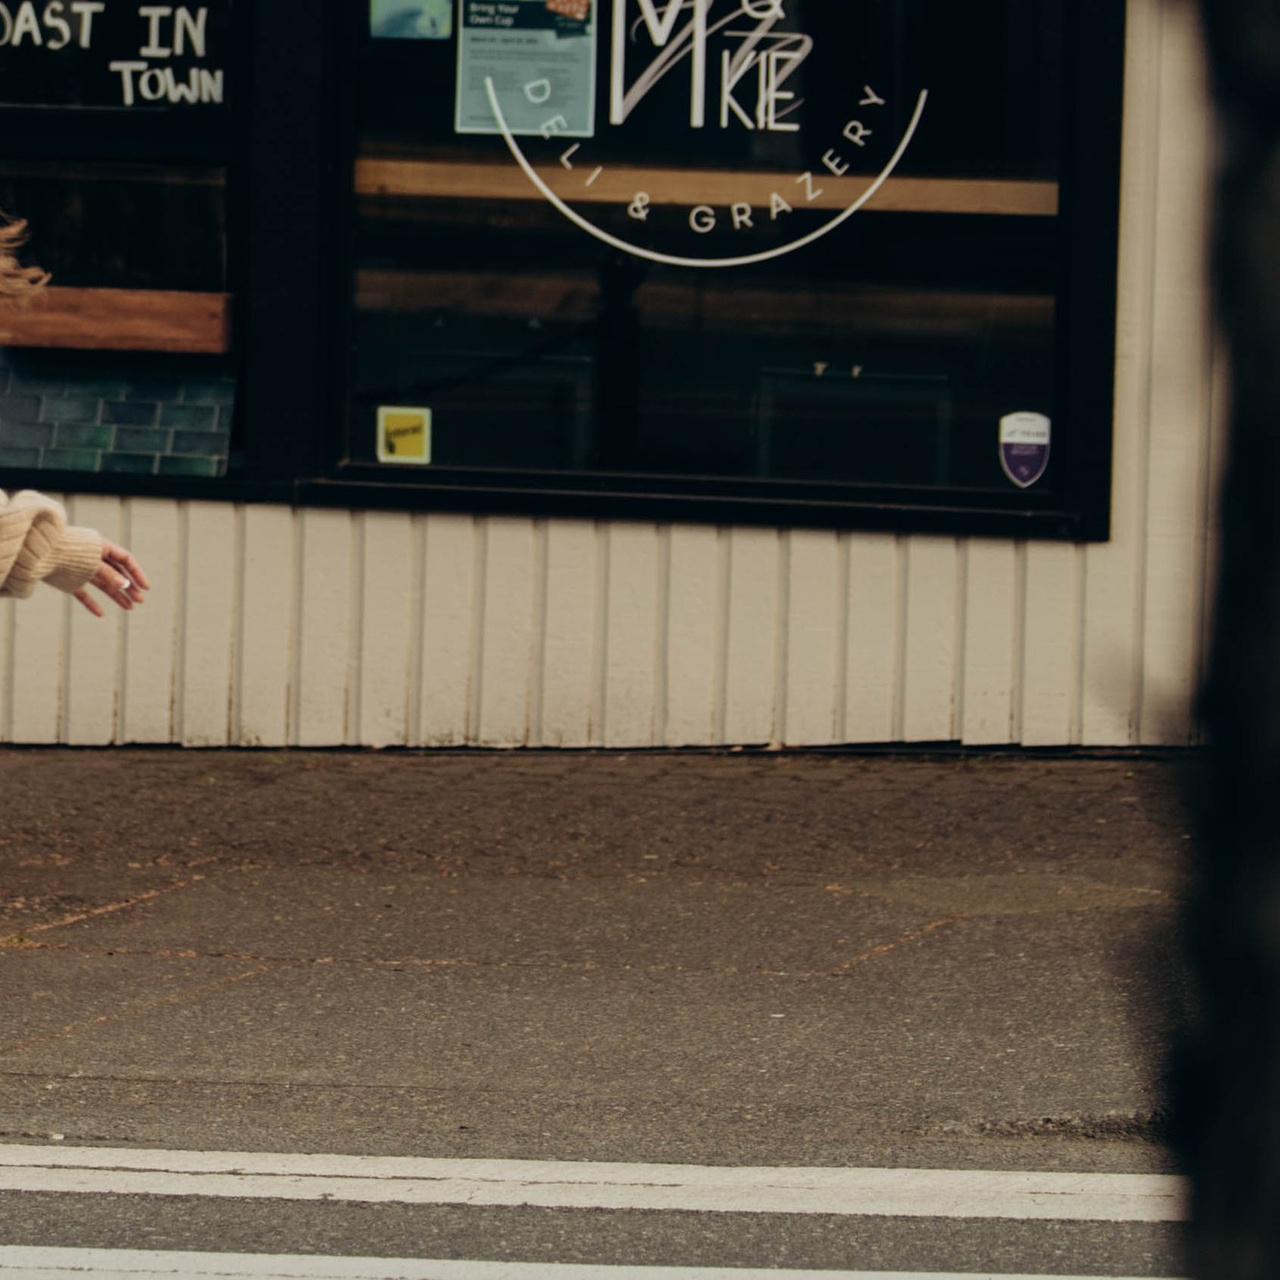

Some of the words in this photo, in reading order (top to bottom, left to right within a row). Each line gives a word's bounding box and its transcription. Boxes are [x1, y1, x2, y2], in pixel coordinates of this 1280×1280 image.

[469, 2, 496, 15] Bring
[495, 15, 514, 27] Cup
[138, 5, 208, 58] IN
[109, 61, 223, 105] TOWN
[523, 77, 602, 187] DELI
[627, 192, 650, 220] &
[688, 84, 886, 234] GRAZERY
